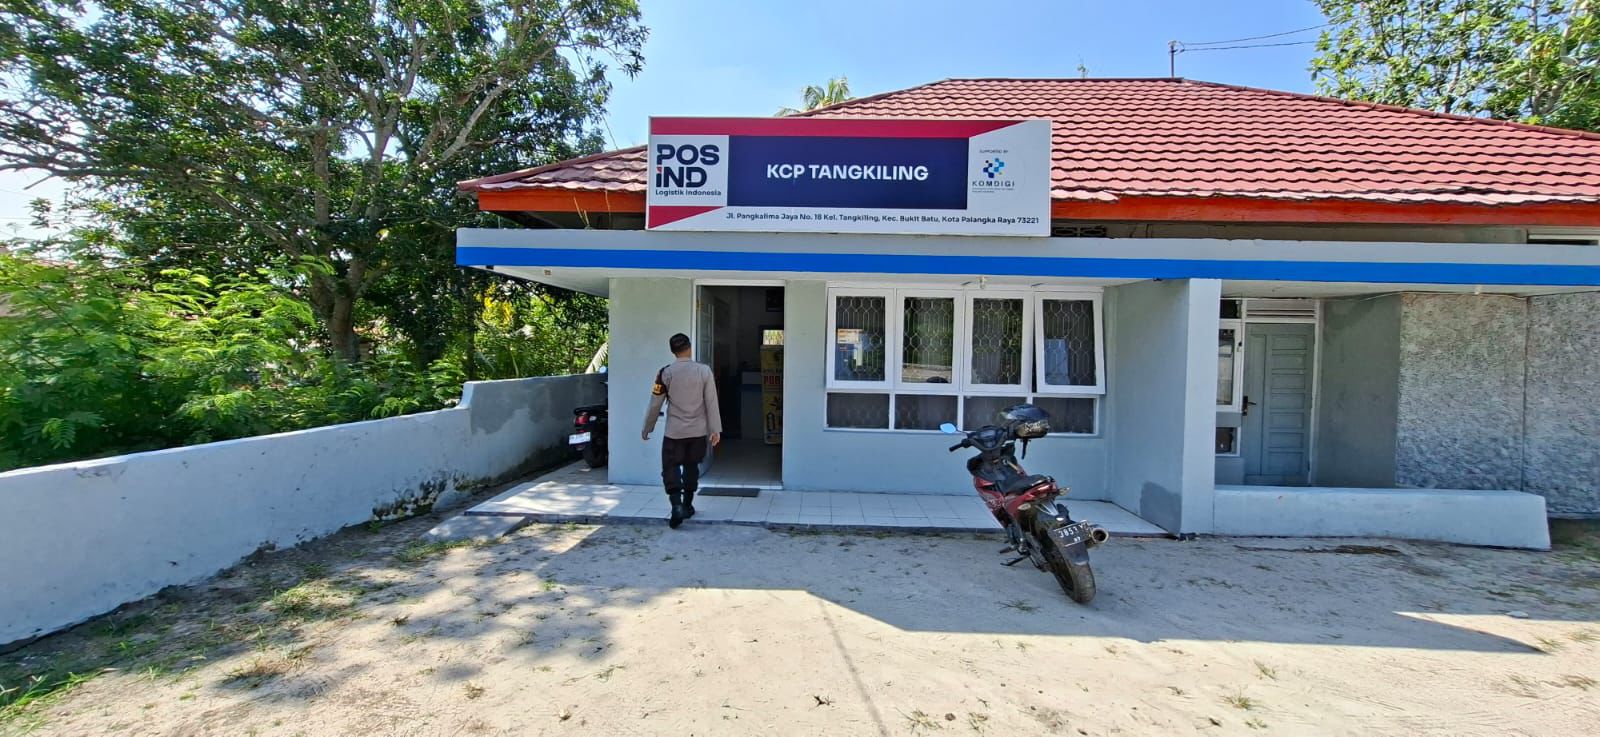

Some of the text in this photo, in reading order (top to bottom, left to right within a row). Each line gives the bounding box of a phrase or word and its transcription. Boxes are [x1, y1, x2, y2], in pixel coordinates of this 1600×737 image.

[656, 144, 720, 166] POS
[767, 164, 929, 181] KCP TANGKILING
[655, 189, 684, 197] Logistik
[736, 213, 780, 221] Pangkalima
[781, 213, 799, 222] Jaya
[839, 214, 881, 222] Tangkiling,
[921, 215, 941, 223] Batu,
[961, 216, 996, 225] Palangka
[997, 216, 1016, 225] Raya
